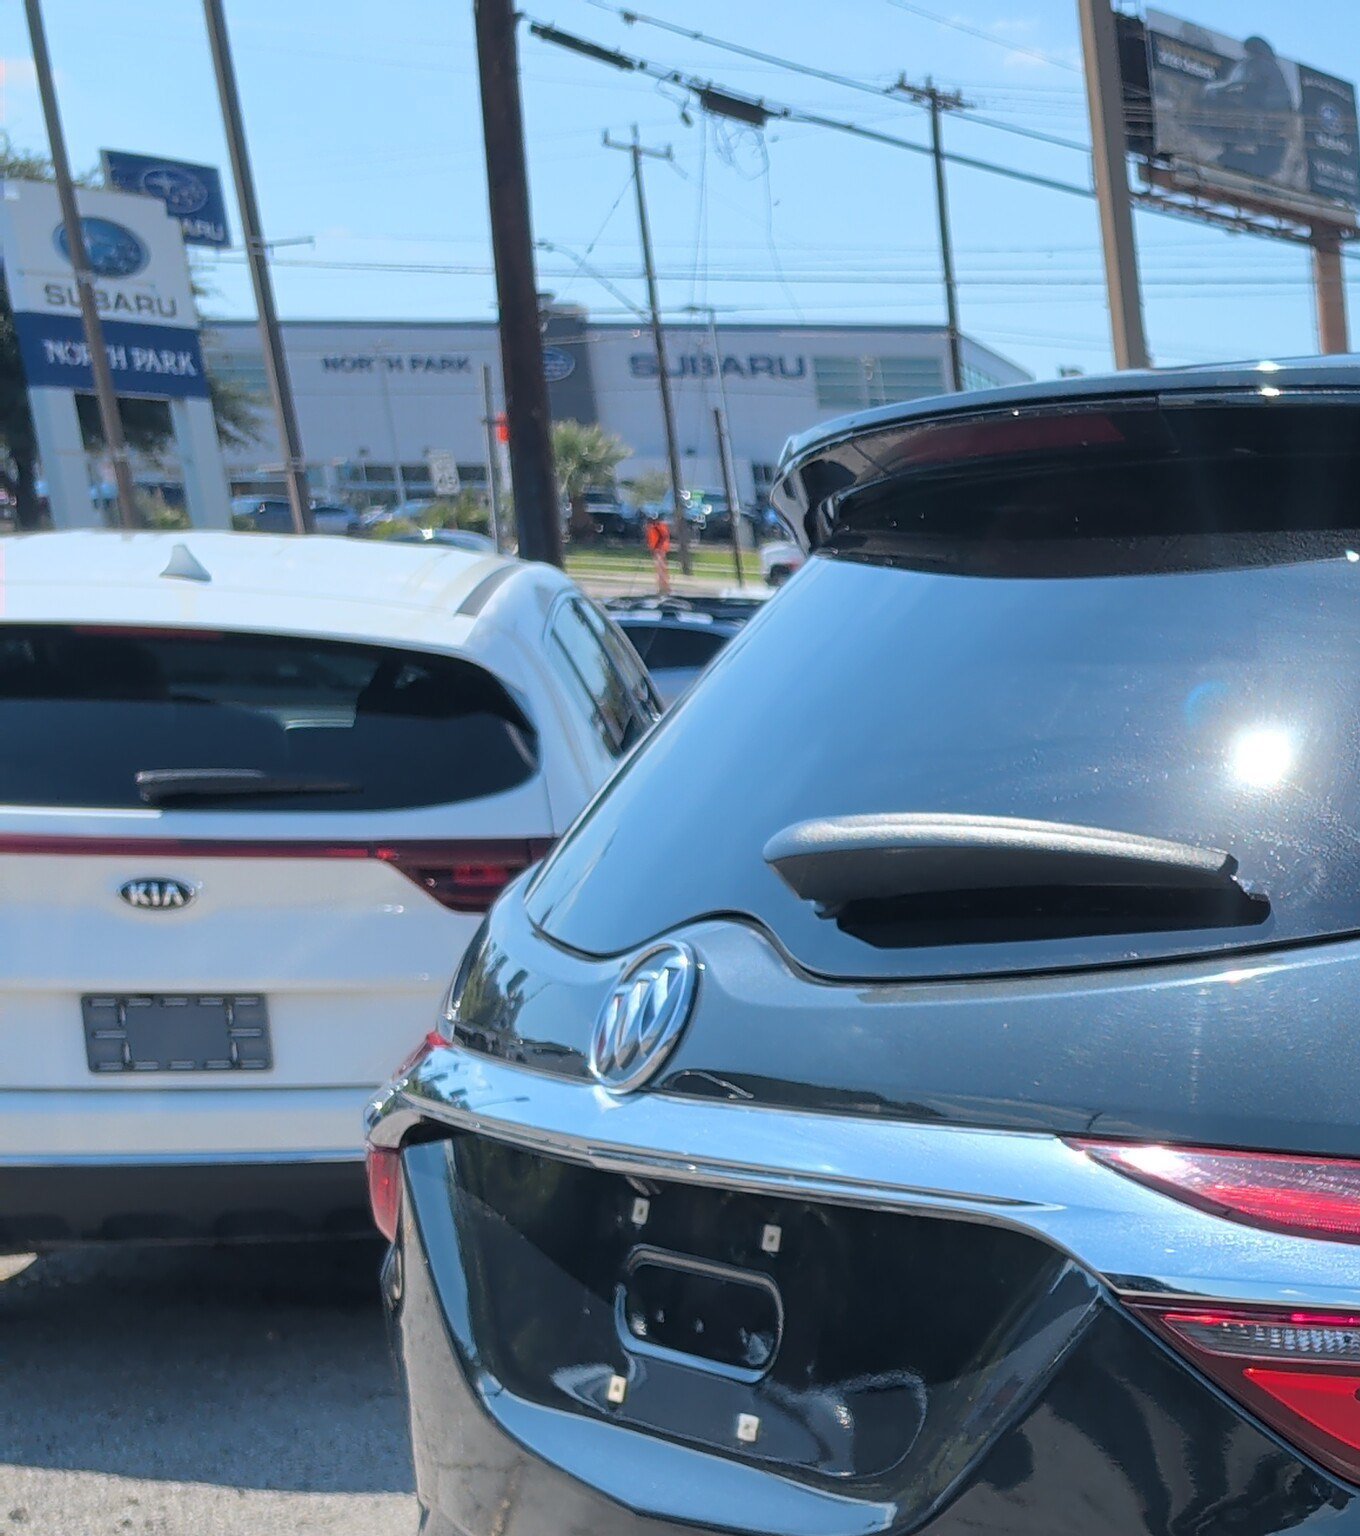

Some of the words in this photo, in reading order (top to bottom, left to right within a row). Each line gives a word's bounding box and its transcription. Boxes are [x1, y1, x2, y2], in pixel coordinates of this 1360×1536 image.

[132, 345, 197, 377] PARK
[409, 355, 471, 374] PARK
[628, 352, 807, 380] SUBARU
[129, 881, 184, 906] KIA
